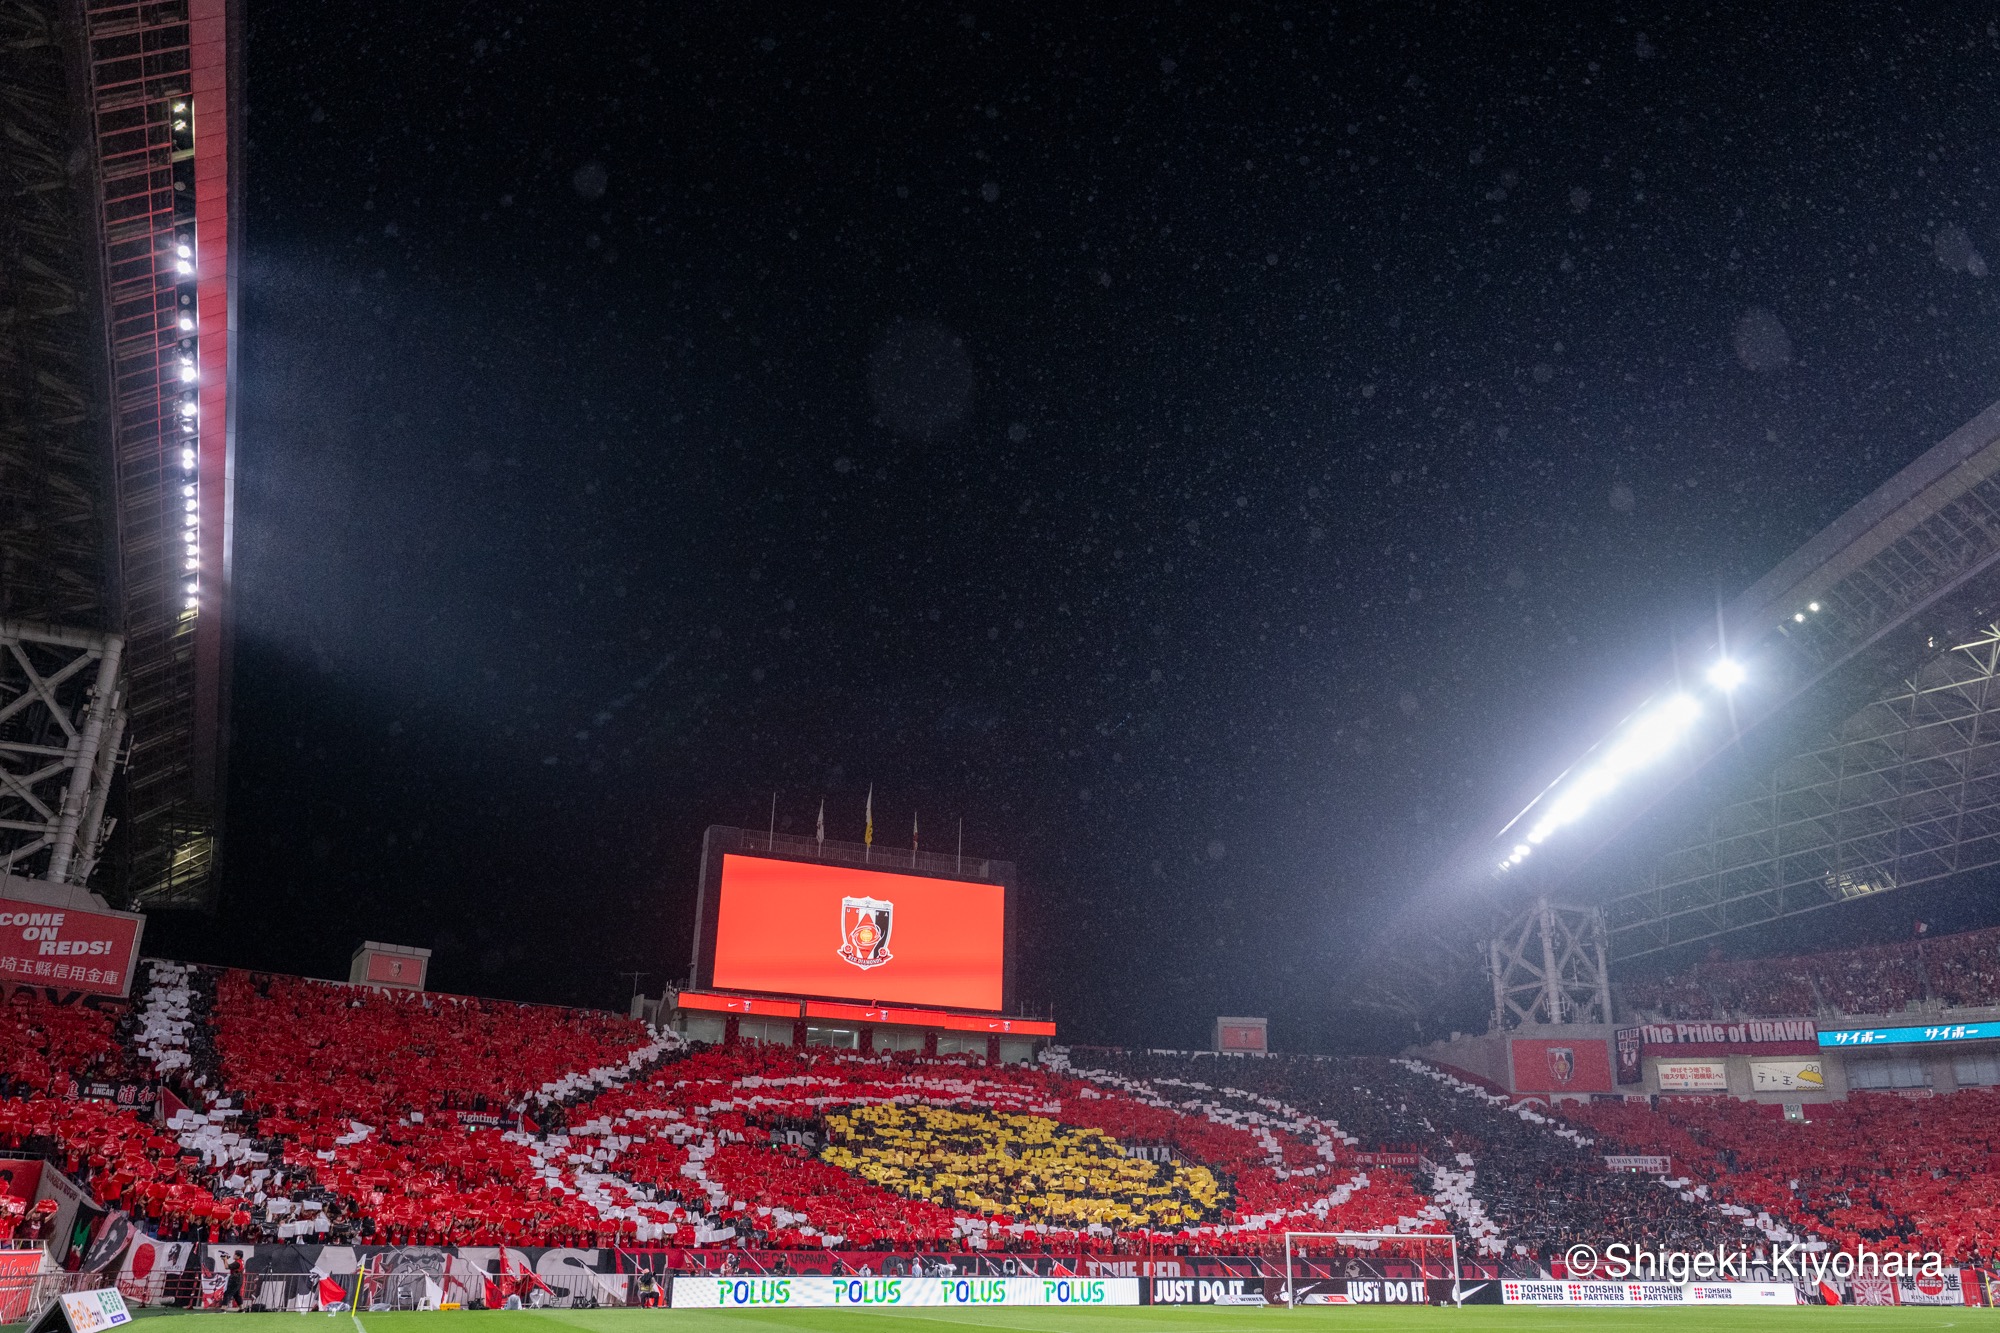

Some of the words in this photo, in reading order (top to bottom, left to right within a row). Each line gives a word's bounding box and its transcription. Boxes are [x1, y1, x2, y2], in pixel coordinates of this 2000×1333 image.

[0, 913, 65, 927] COME
[22, 927, 58, 941] ON
[38, 940, 113, 956] REDS!
[0, 957, 119, 985] 埼玉縣信用金庫
[1641, 1025, 1674, 1044] The
[1676, 1024, 1725, 1043] Pride
[1728, 1023, 1746, 1043] of
[1749, 1021, 1816, 1042] URAWA
[1834, 1032, 1887, 1045] サイボー
[1924, 1026, 1979, 1040] サイボー
[457, 1111, 499, 1125] Fighting
[790, 1253, 828, 1264] URAWA
[1520, 1285, 1563, 1293] TOHSHIN
[1583, 1285, 1624, 1293] TOHSHIN
[1642, 1286, 1683, 1294] TOHSHIN
[1944, 1274, 1960, 1291] 進
[718, 1280, 790, 1304] POLUS
[833, 1280, 902, 1303] POLUS
[942, 1280, 1005, 1303] POLUS
[1043, 1281, 1105, 1303] POLUS
[1155, 1281, 1194, 1302] JUST
[1199, 1281, 1225, 1302] DO
[1347, 1282, 1380, 1302] JUST
[1384, 1282, 1408, 1302] DO
[1521, 1293, 1564, 1301] PARTNERS
